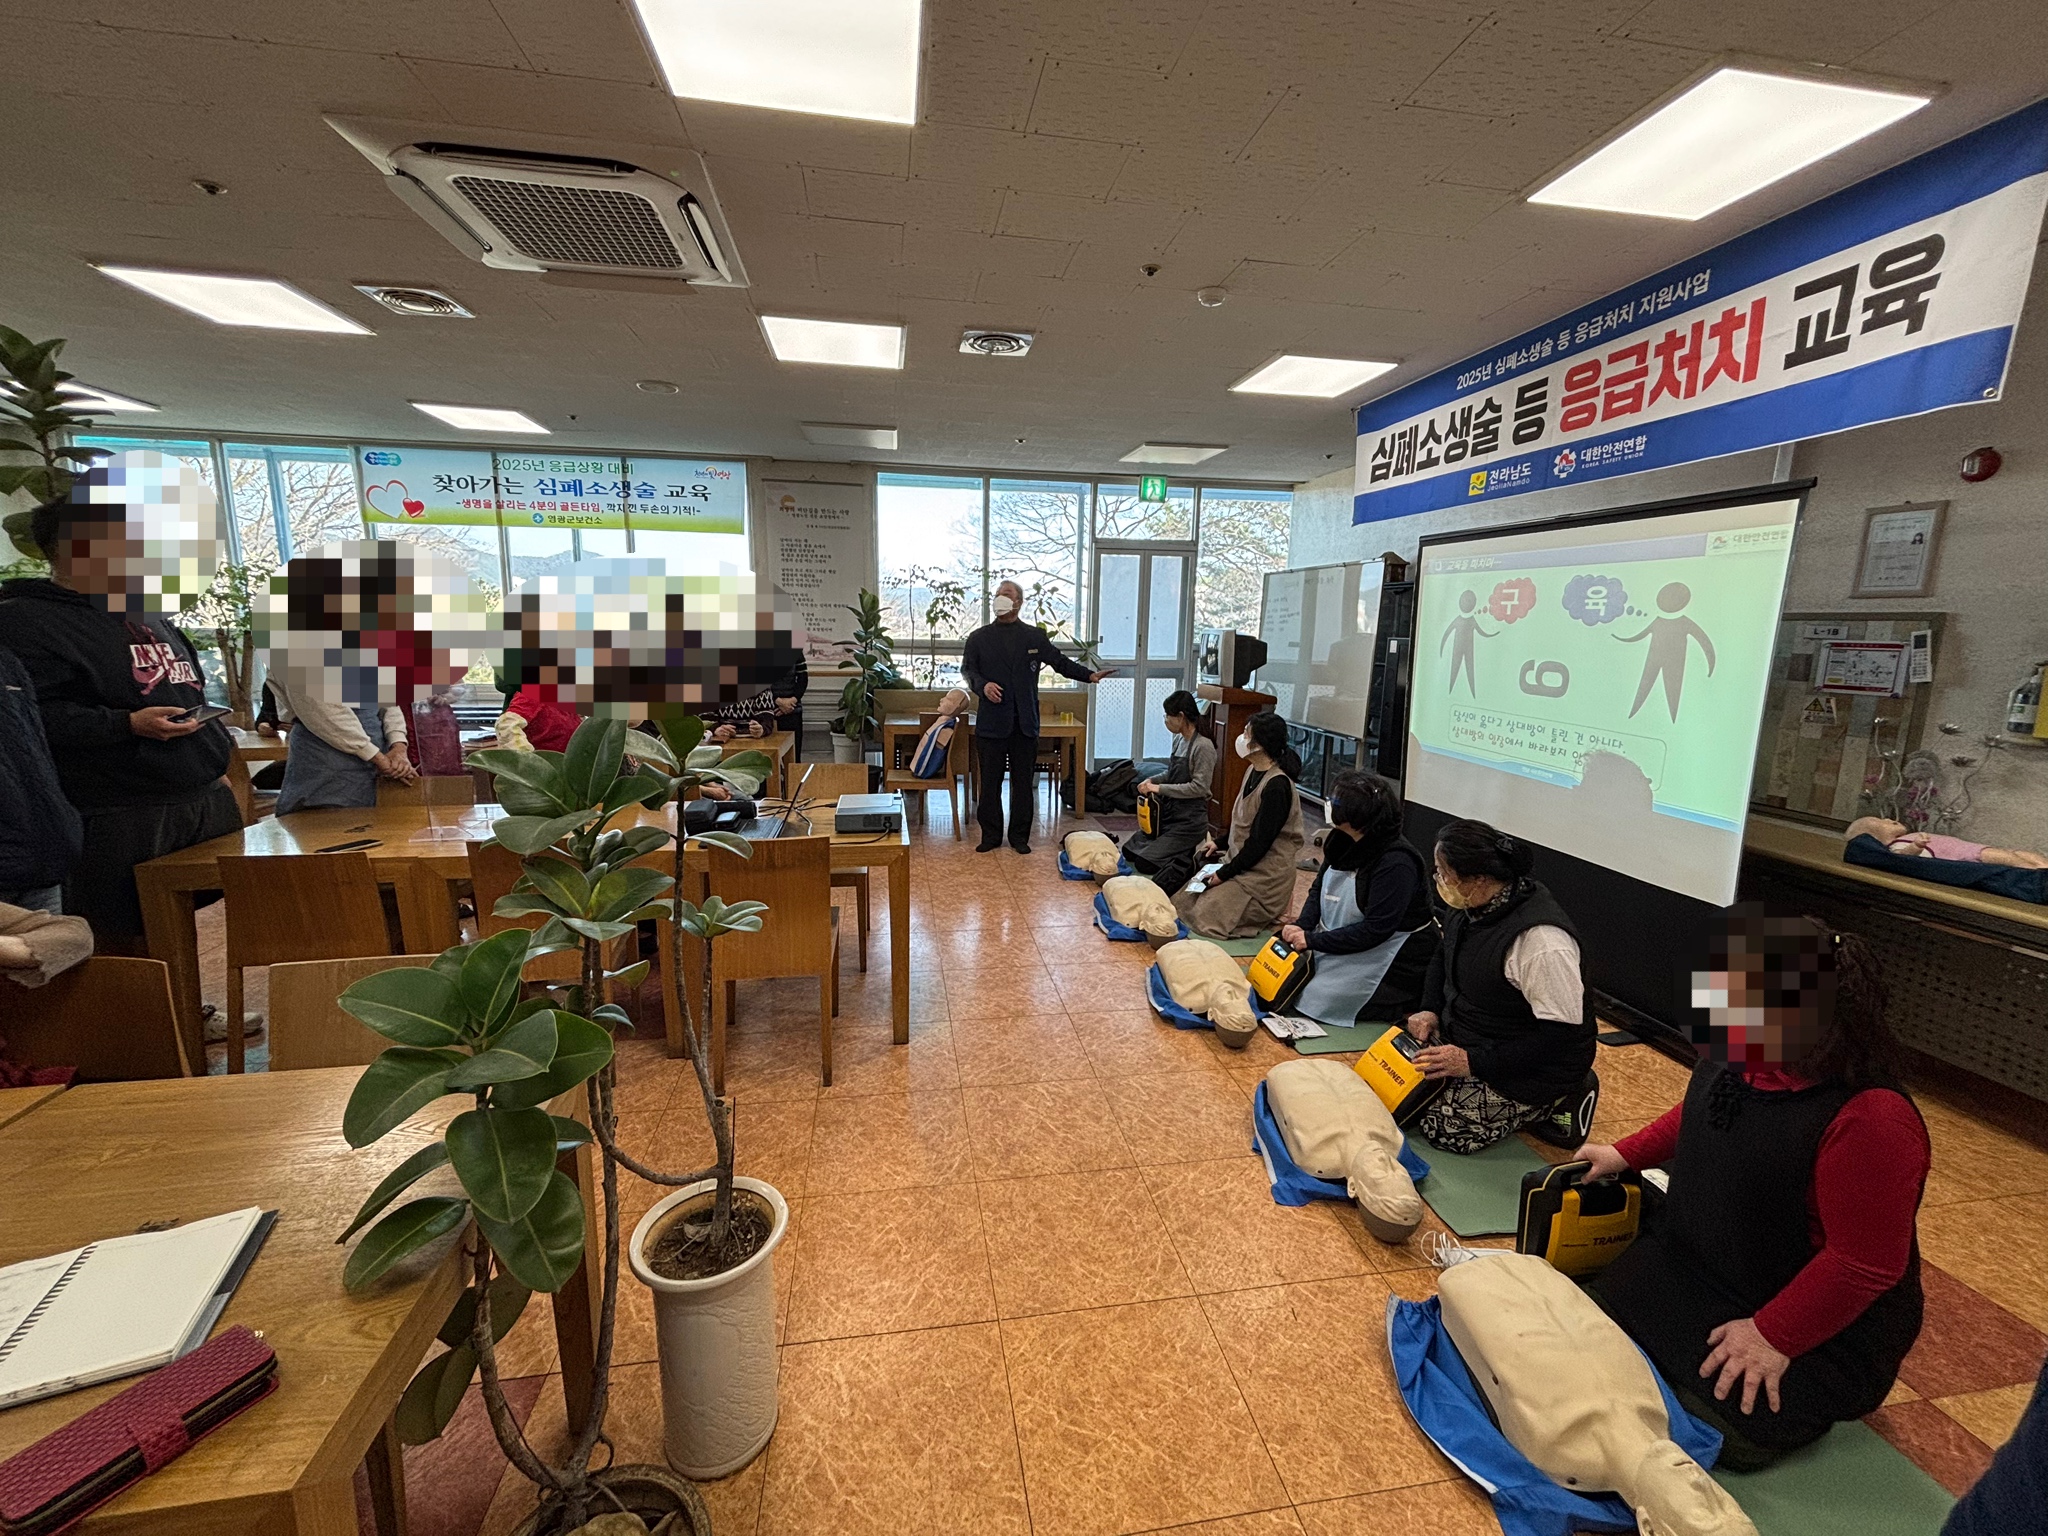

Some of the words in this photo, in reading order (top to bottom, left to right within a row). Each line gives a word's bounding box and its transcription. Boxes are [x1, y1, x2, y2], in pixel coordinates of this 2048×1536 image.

[1456, 360, 1492, 390] 2025년
[1495, 338, 1554, 376] 심폐소생술
[1556, 329, 1571, 351] 등
[1574, 302, 1635, 344] 응급처치
[1639, 269, 1711, 316] 지원사업
[1370, 396, 1503, 484] 심폐소생술
[1511, 376, 1549, 446] 등
[1559, 296, 1767, 433] 응급처치
[1782, 233, 1946, 371] 교육
[1581, 434, 1647, 462] 대한안전연합
[1582, 461, 1599, 469] KOREA
[1602, 456, 1622, 465] SAFETY
[1624, 452, 1644, 460] UNION
[492, 458, 545, 472] 2025년
[548, 460, 604, 474] 응급상황
[607, 462, 634, 475] 대비
[1489, 462, 1532, 485] 전라남도
[432, 473, 525, 495] 찾아가는
[533, 476, 658, 499] 심폐소생술
[663, 483, 712, 502] 교육
[496, 499, 527, 510] 살리는
[529, 500, 557, 511] 4분의
[559, 502, 605, 514] 골든타임,
[639, 503, 669, 515] 두손의
[548, 514, 603, 525] 영광군보건소
[1500, 588, 1519, 615] 구
[1584, 585, 1608, 617] 육
[1453, 710, 1476, 723] 당신이
[1506, 720, 1546, 737] 상대방이
[1551, 727, 1568, 743] 틀린
[1574, 731, 1584, 745] 건
[1452, 726, 1484, 742] 상대방의
[1488, 733, 1523, 748] 입장에서
[1528, 741, 1567, 756] 바라보지
[1572, 750, 1584, 767] 않
[1263, 961, 1280, 979] TRAINER
[1379, 1058, 1405, 1087] TRAINER
